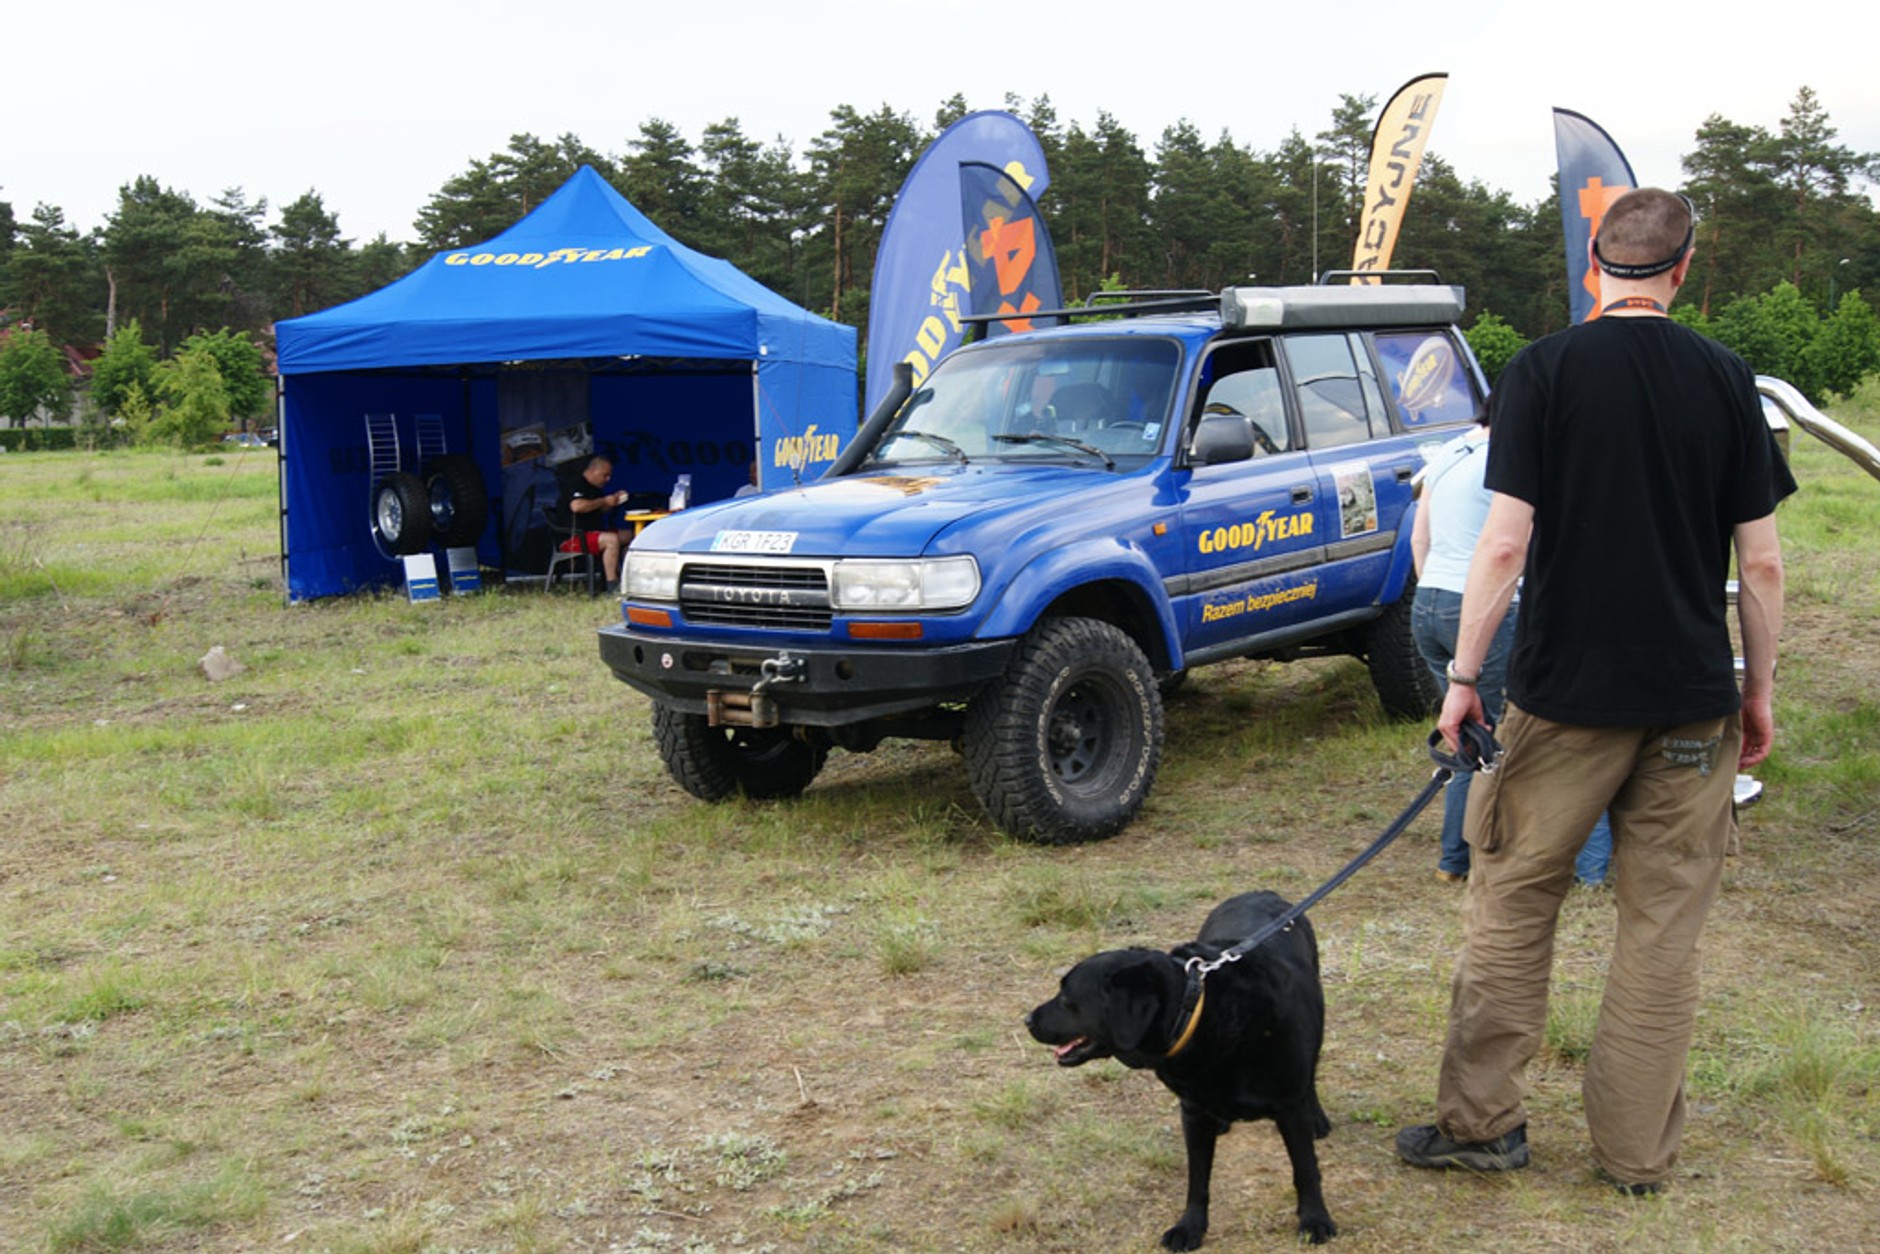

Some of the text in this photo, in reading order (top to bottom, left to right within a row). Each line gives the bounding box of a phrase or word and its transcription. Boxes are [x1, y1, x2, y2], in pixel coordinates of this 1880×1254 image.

[444, 246, 653, 269] GOODYEAR
[721, 532, 793, 551] KGR 1F23
[1198, 509, 1314, 554] GOODYEAR
[713, 587, 791, 604] TOYOTA
[1202, 600, 1245, 623] Razem
